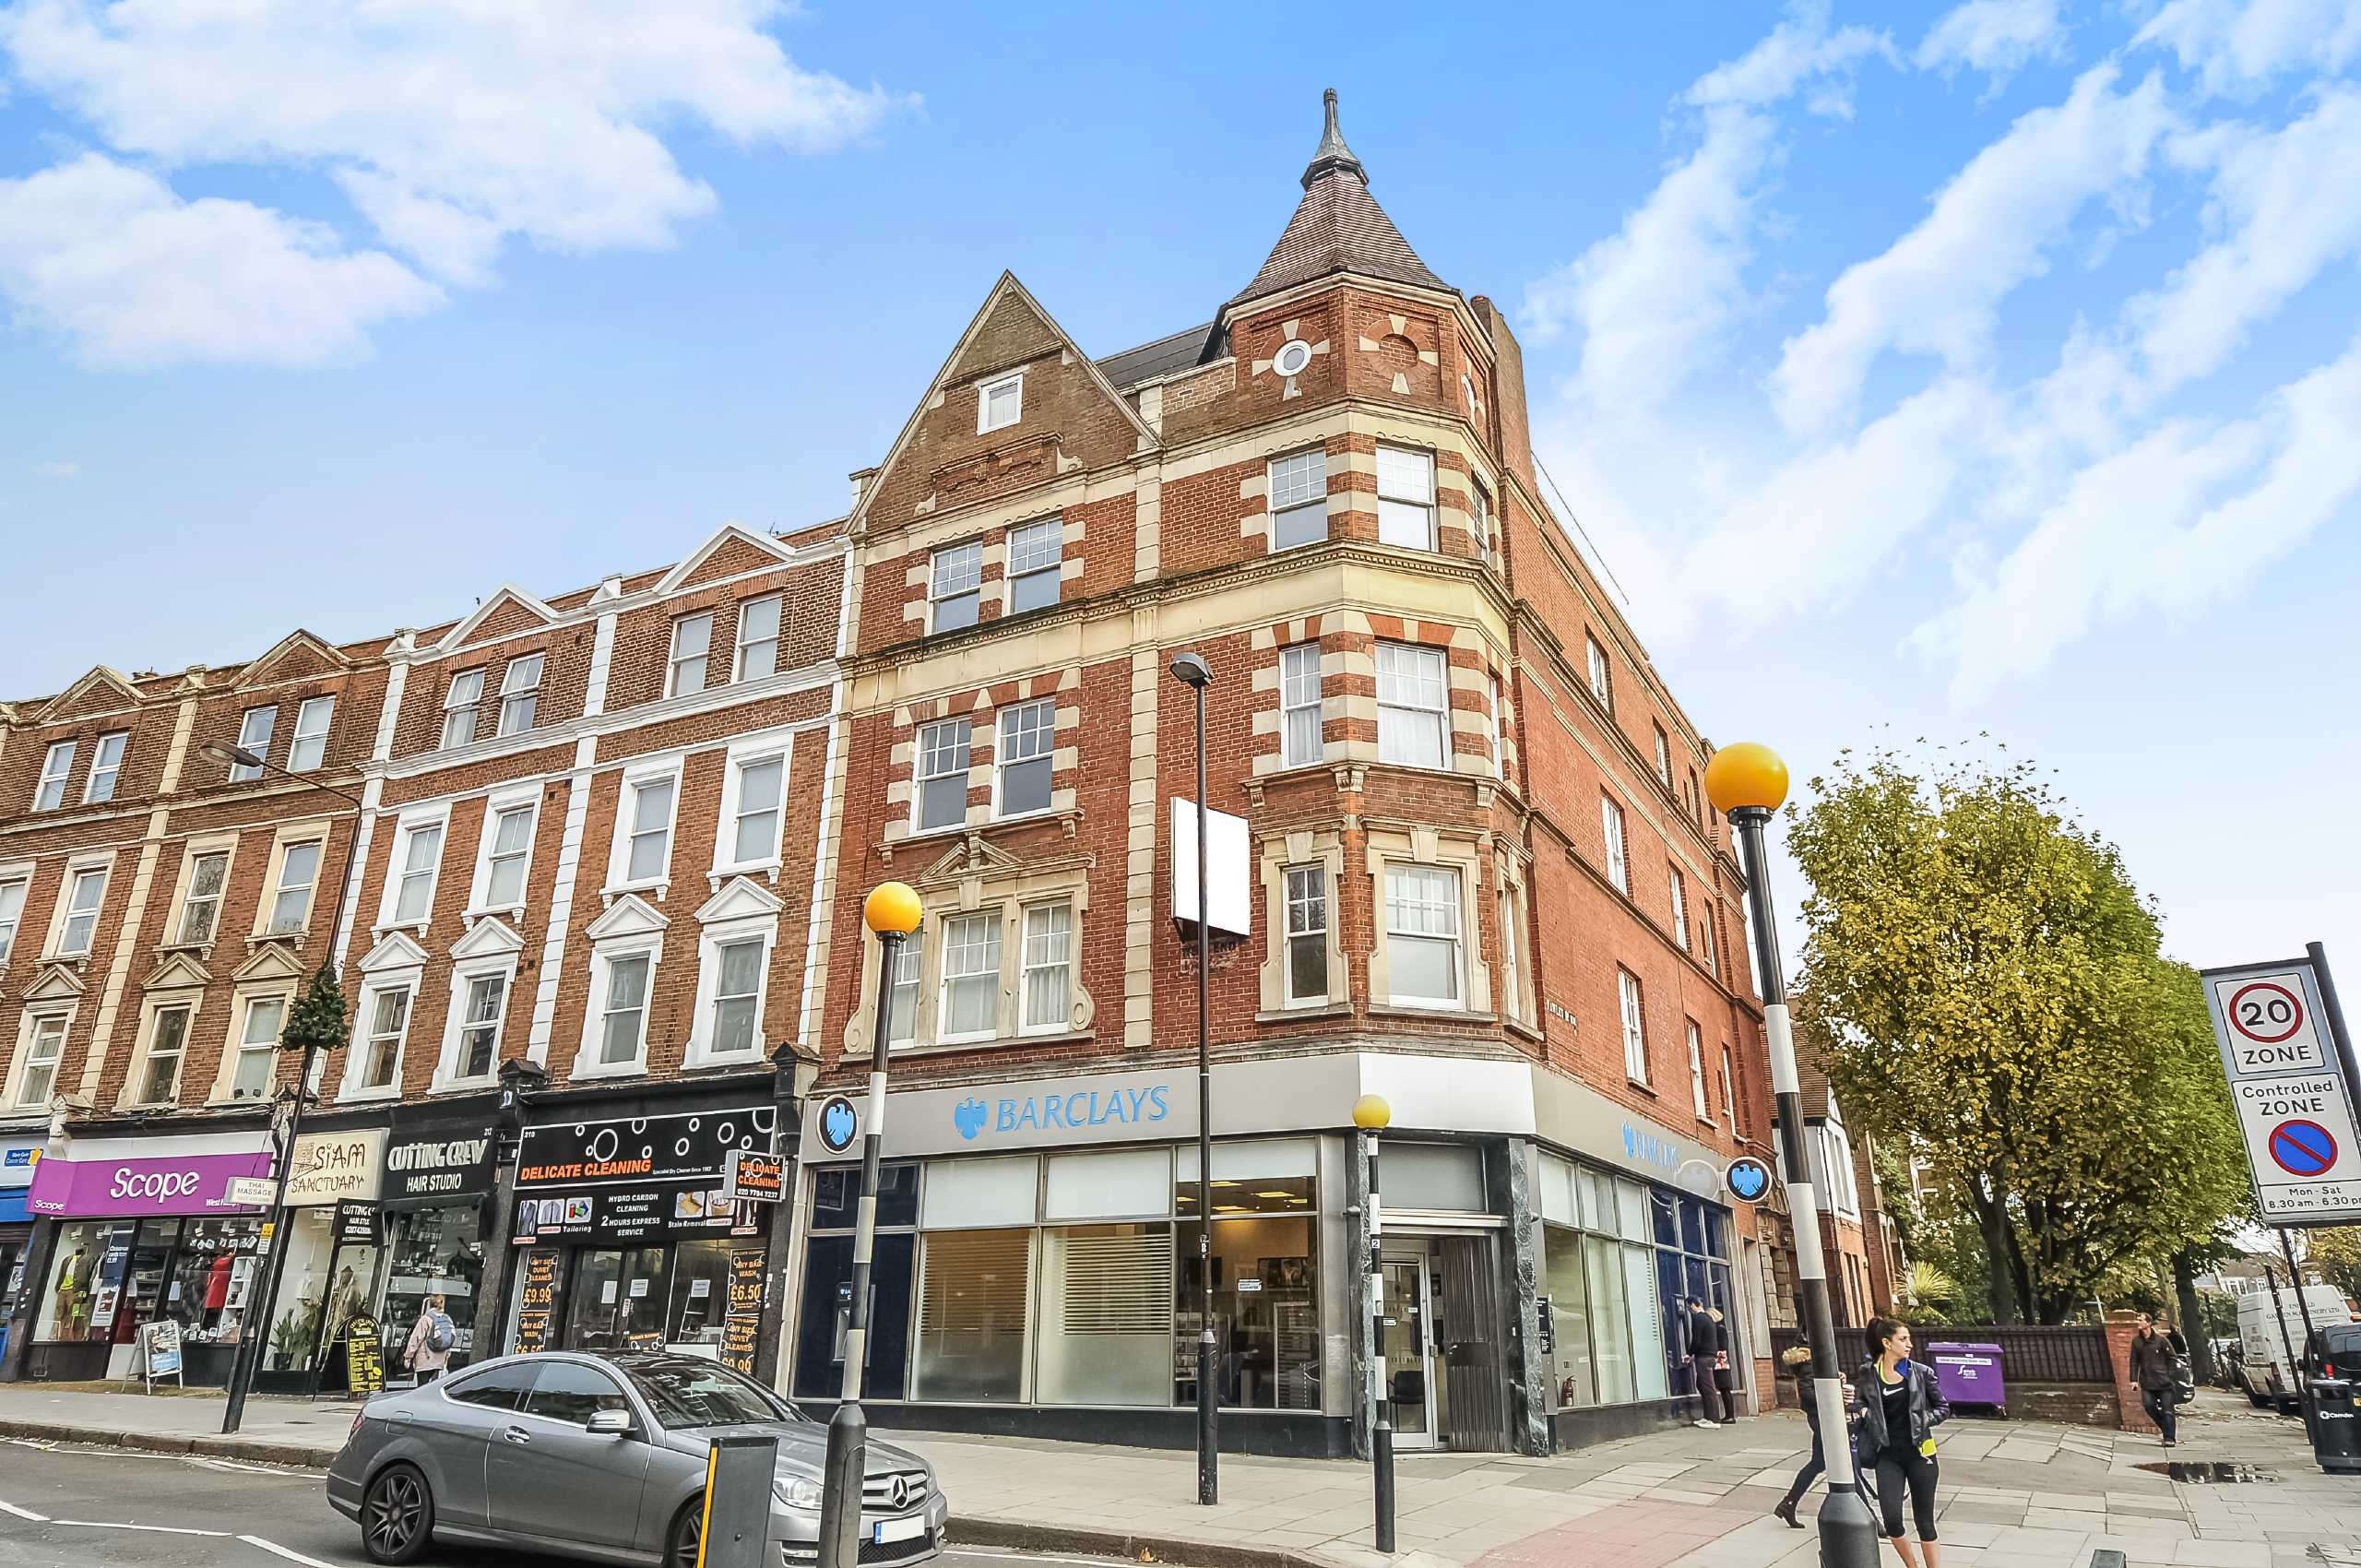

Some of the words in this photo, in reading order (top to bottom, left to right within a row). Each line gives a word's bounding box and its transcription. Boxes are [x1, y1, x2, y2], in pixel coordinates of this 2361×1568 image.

[2240, 999, 2292, 1027] 20
[2242, 1045, 2312, 1065] ZONE
[2242, 1080, 2333, 1099] Controlled
[996, 1085, 1170, 1133] BARCLAYS
[2259, 1098, 2325, 1116] ZONE
[446, 1139, 489, 1167] CREW
[520, 1163, 582, 1181] DELICATE
[584, 1158, 651, 1177] CLEANING
[740, 1162, 780, 1175] DELICATE
[110, 1167, 200, 1205] Scope
[291, 1174, 364, 1194] SANCTUARY
[406, 1176, 428, 1193] HAIR
[429, 1172, 462, 1192] STUDIO
[738, 1174, 780, 1188] CLEANING
[237, 1187, 273, 1196] MASSAGE
[2288, 1188, 2313, 1196] Mon
[2321, 1185, 2342, 1194] Sat
[34, 1199, 65, 1211] Scope
[608, 1194, 631, 1203] HYDRO
[2268, 1199, 2295, 1208] 8.30
[2321, 1196, 2349, 1206] 6.30
[616, 1204, 649, 1213] CLEANING
[600, 1215, 609, 1227] 2
[632, 1217, 661, 1225] EXPRESS
[563, 1225, 592, 1233] Tailoring
[617, 1228, 645, 1237] SERVICE
[1372, 1240, 1379, 1248] 2
[524, 1288, 552, 1303] £9.99
[730, 1283, 761, 1301] £6.50
[730, 1335, 749, 1343] DUVET
